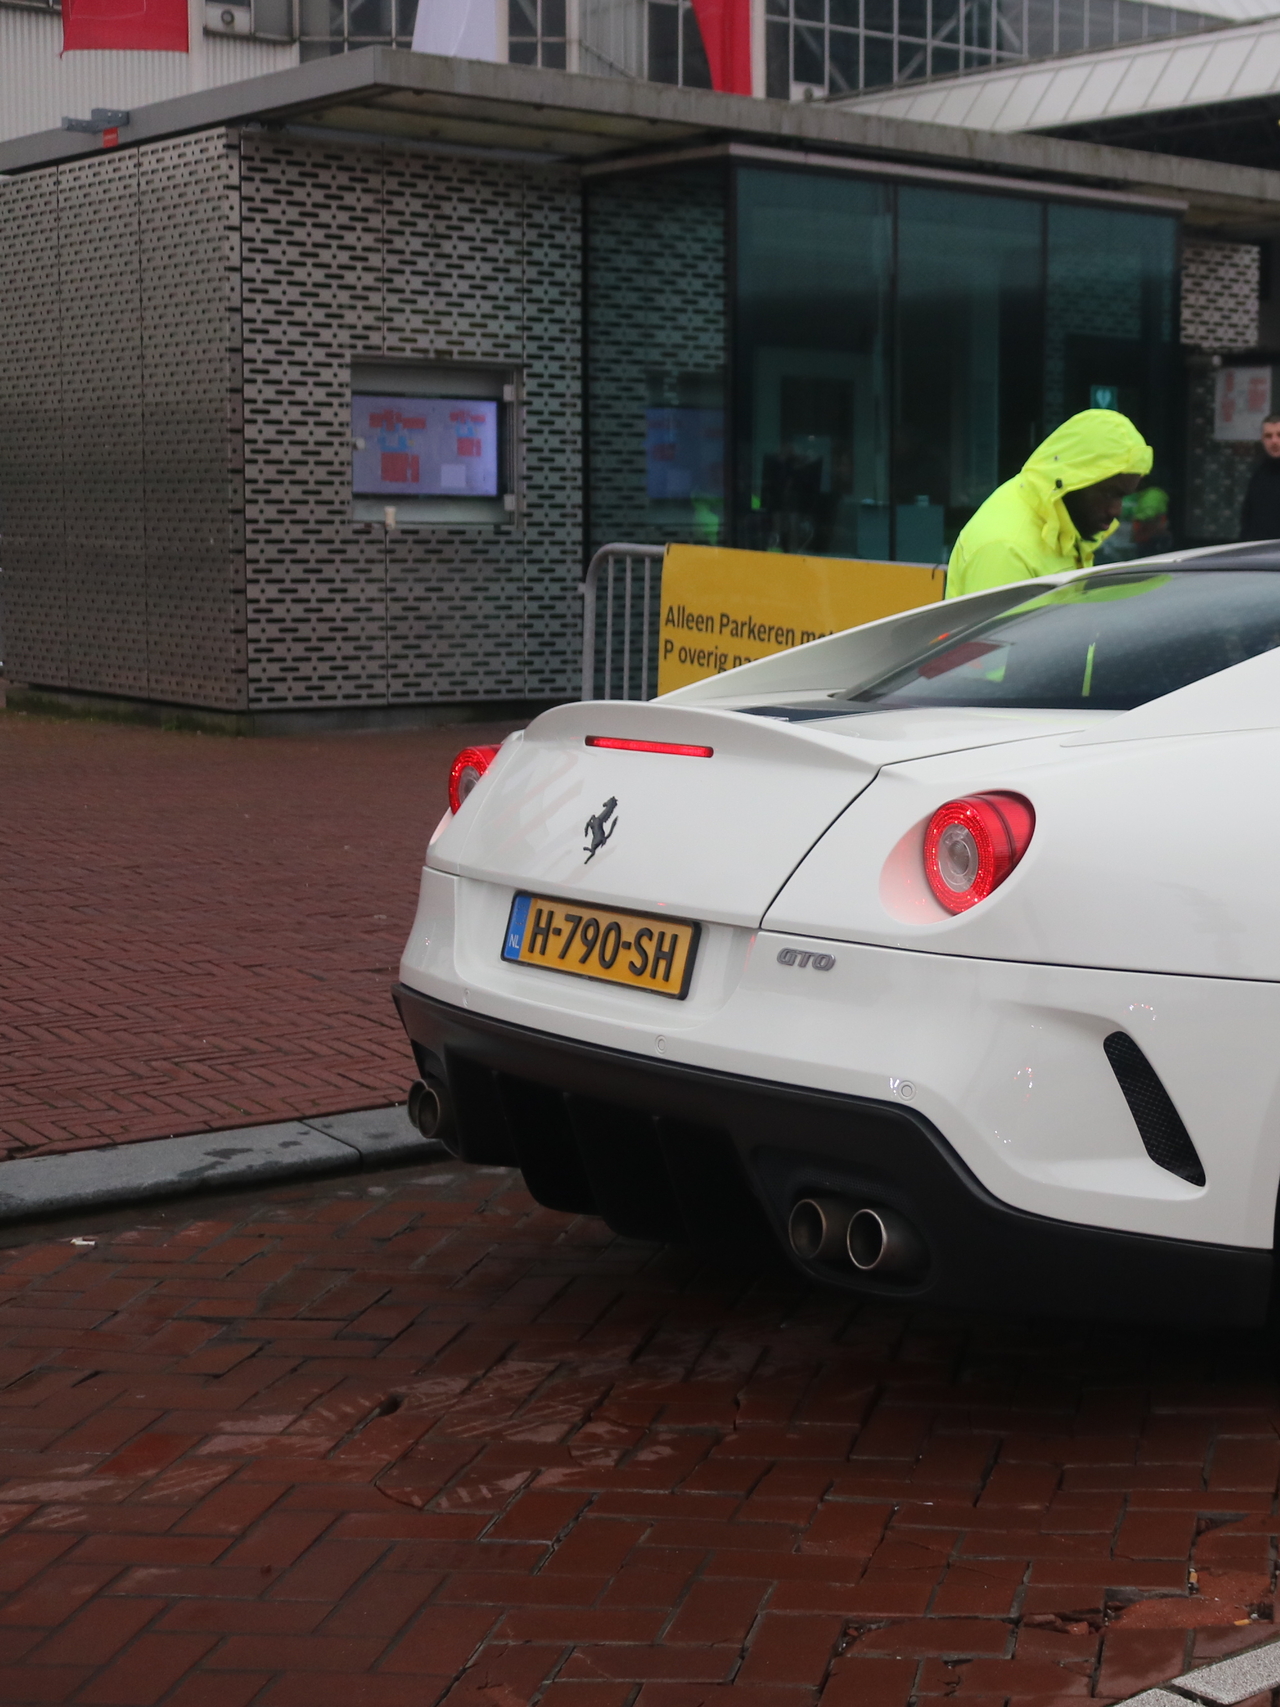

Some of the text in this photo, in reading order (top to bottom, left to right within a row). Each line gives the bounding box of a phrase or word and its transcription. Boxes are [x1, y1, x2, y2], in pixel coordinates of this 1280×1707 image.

[665, 604, 714, 634] Alleen
[719, 611, 796, 647] Parkeren
[663, 638, 674, 661] P
[678, 645, 729, 674] overig
[507, 932, 520, 950] NL
[527, 907, 679, 983] H-790-SH
[777, 946, 836, 972] GTO
